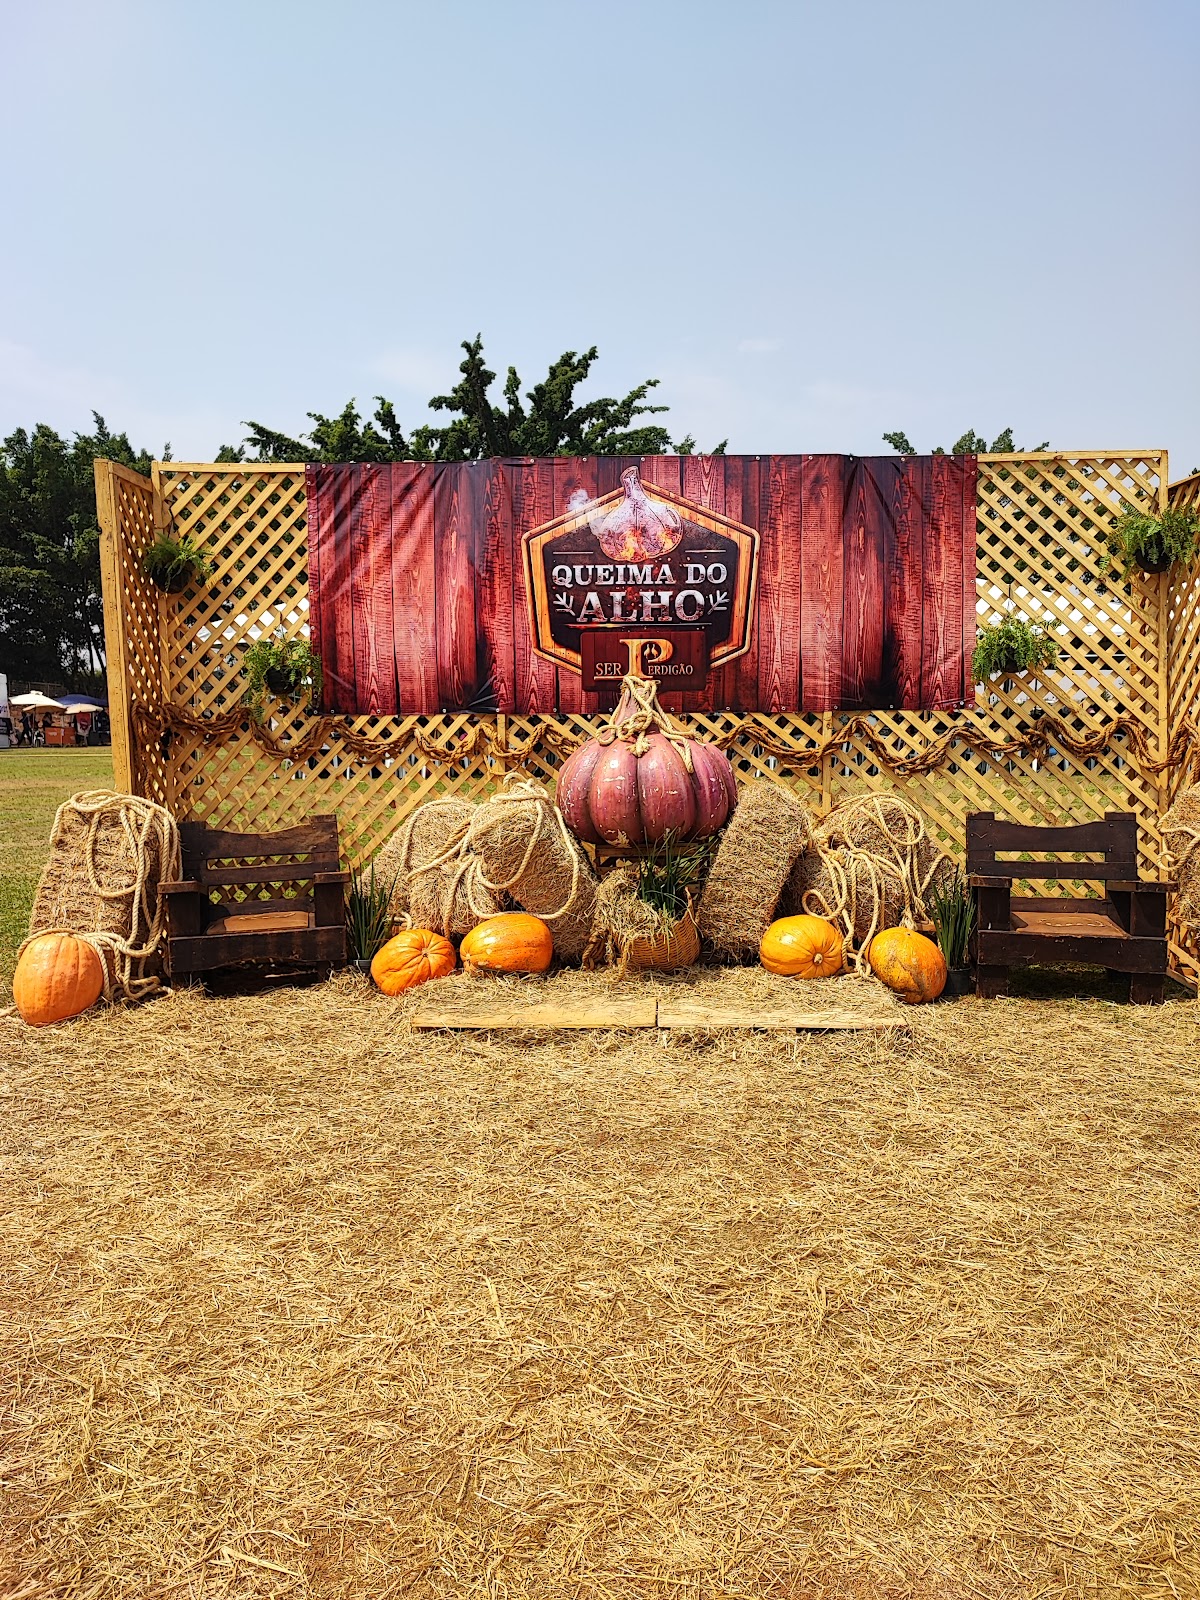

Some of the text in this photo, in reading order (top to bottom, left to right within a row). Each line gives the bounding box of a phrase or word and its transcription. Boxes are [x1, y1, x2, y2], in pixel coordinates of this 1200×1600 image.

[551, 562, 728, 588] QUEIMA DO
[576, 589, 706, 623] ALHO
[595, 638, 694, 681] SER PERDIGÃO
